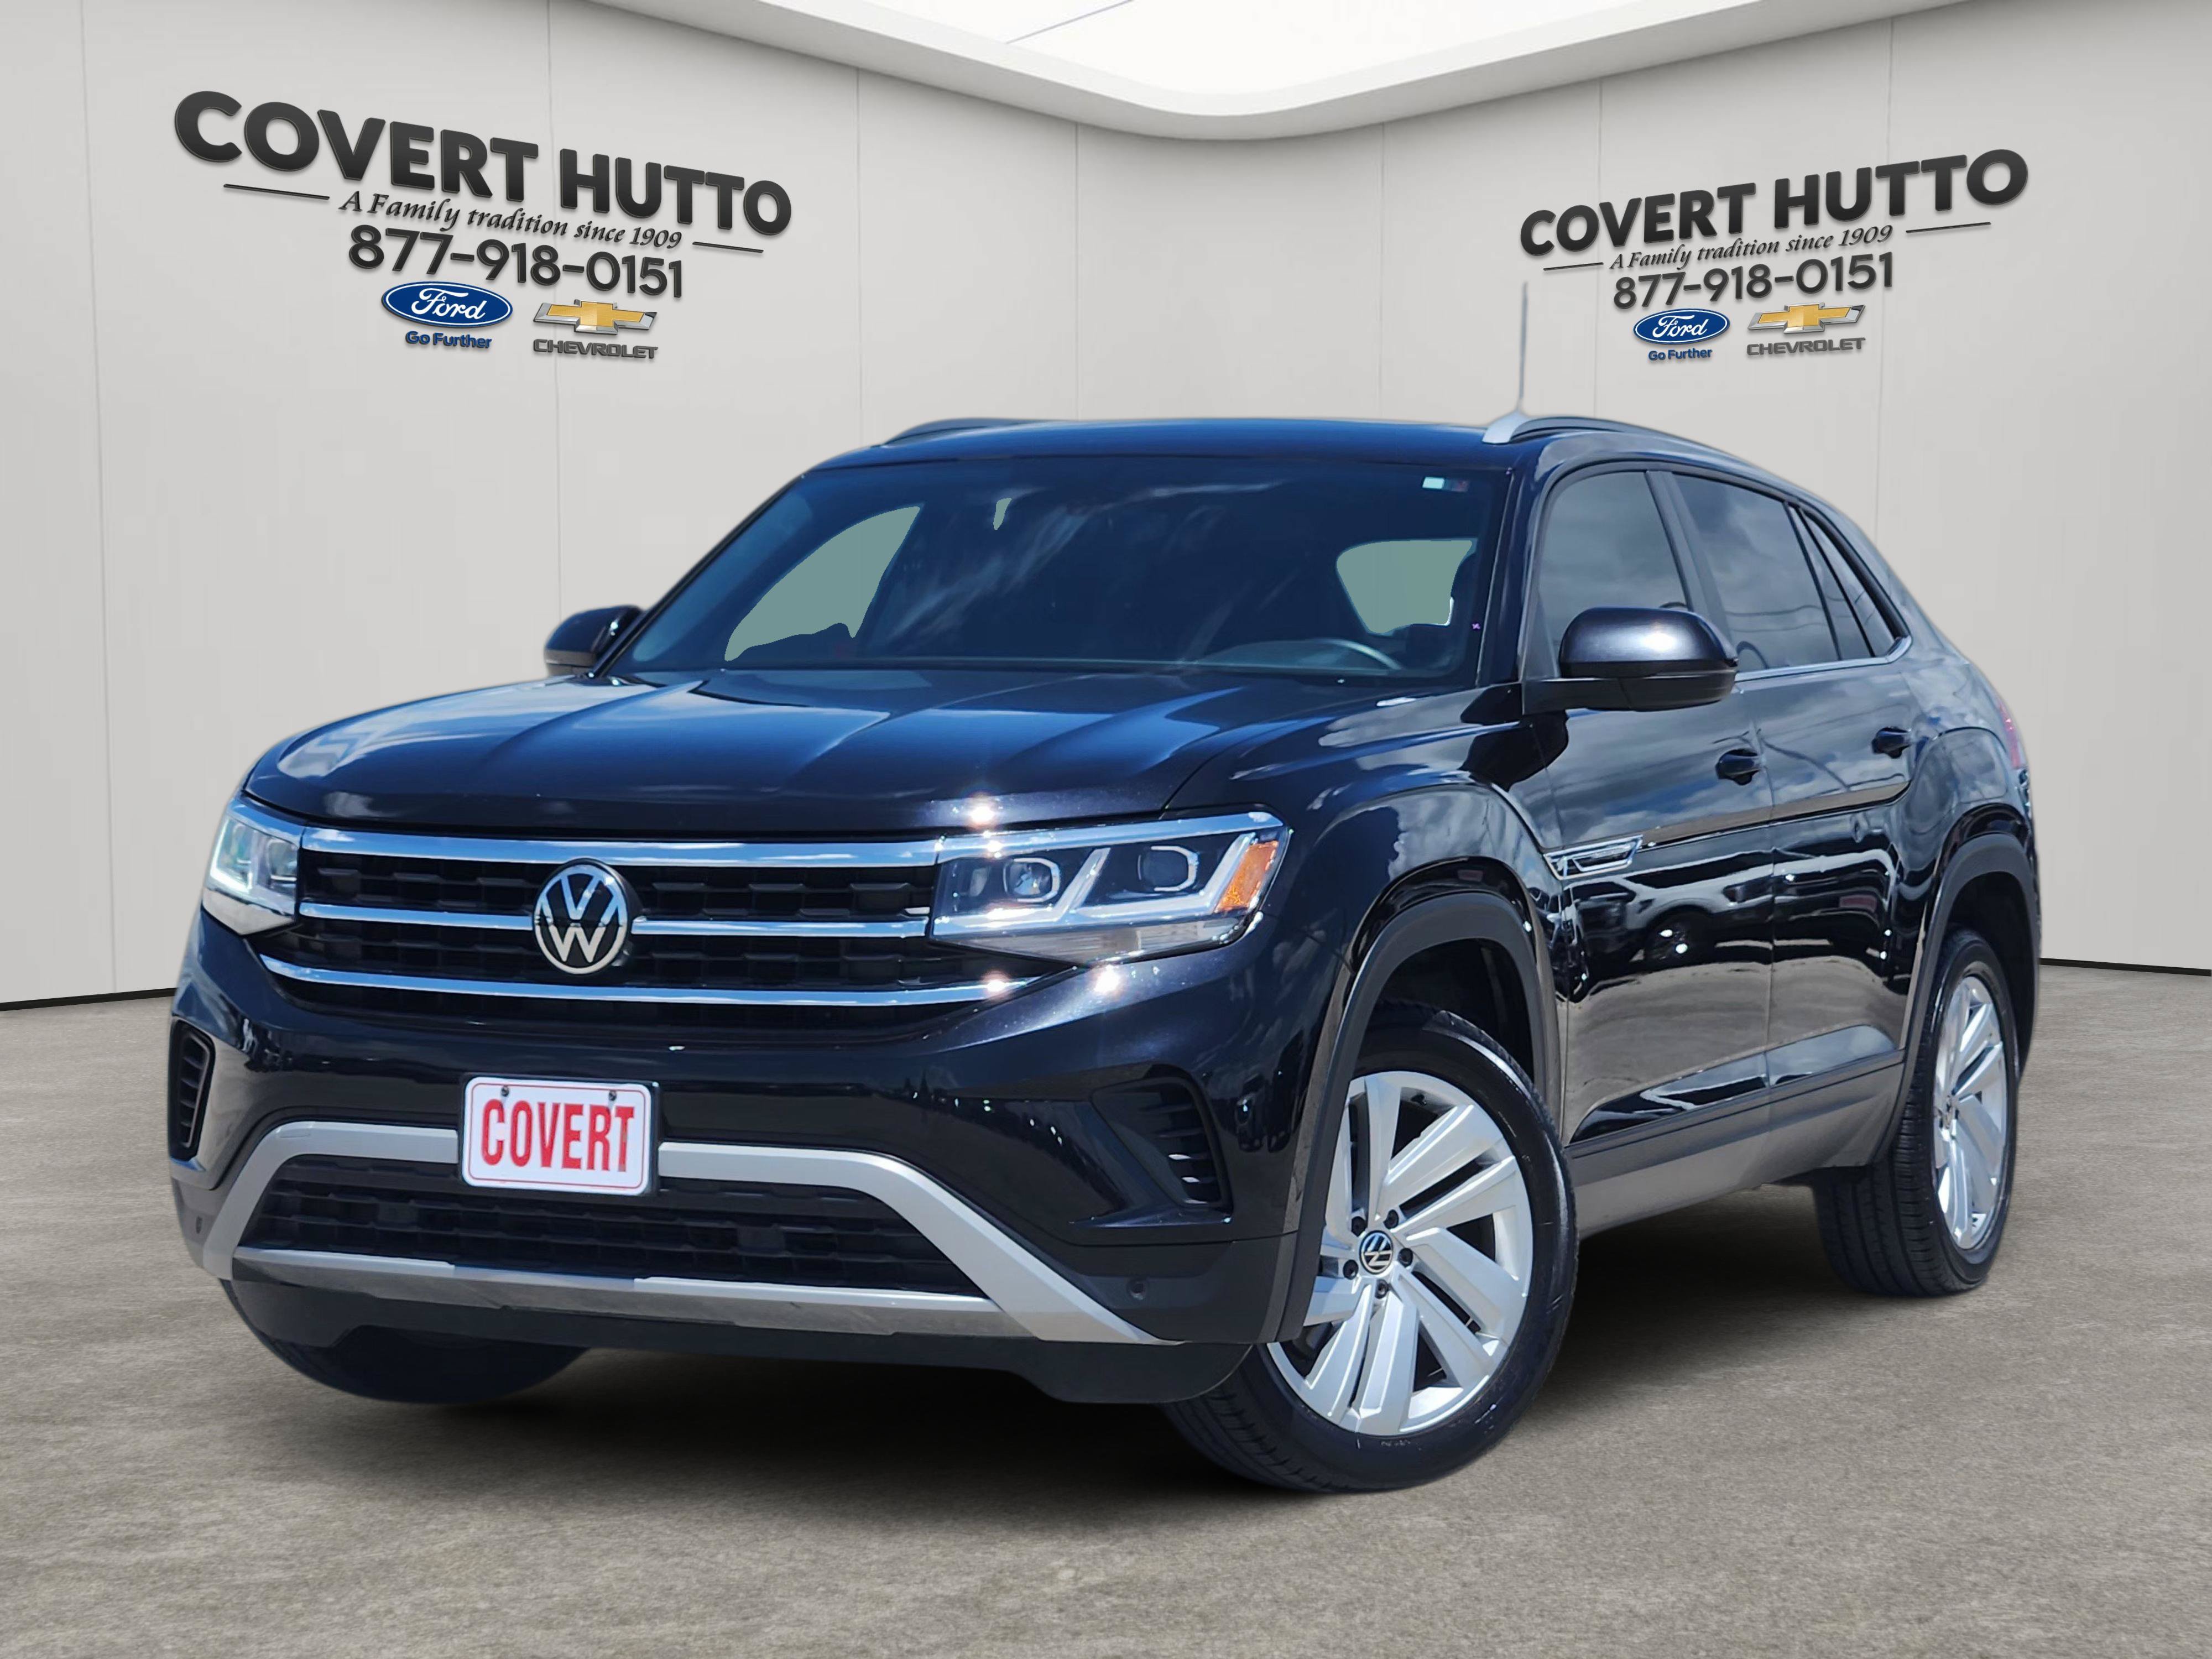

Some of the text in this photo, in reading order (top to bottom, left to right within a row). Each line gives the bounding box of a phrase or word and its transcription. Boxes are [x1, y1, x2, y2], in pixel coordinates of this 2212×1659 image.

[175, 90, 791, 236] COVERT HUTTO
[338, 191, 682, 248] A Family tradition since 1909
[1520, 149, 2028, 256] COVERT HUTTO
[349, 225, 682, 298] 877-918-0151
[1609, 225, 1893, 270] A Family tradition since 1909
[1614, 252, 1892, 309] 877-918-0151
[411, 288, 487, 320] Ford
[1652, 315, 1709, 337] Ford
[406, 331, 492, 348] Go Further
[533, 338, 659, 359] CHEVROLET
[1648, 348, 1712, 361] Go Further
[1746, 337, 1866, 356] CHEVROLET
[482, 1098, 635, 1173] COVERT
